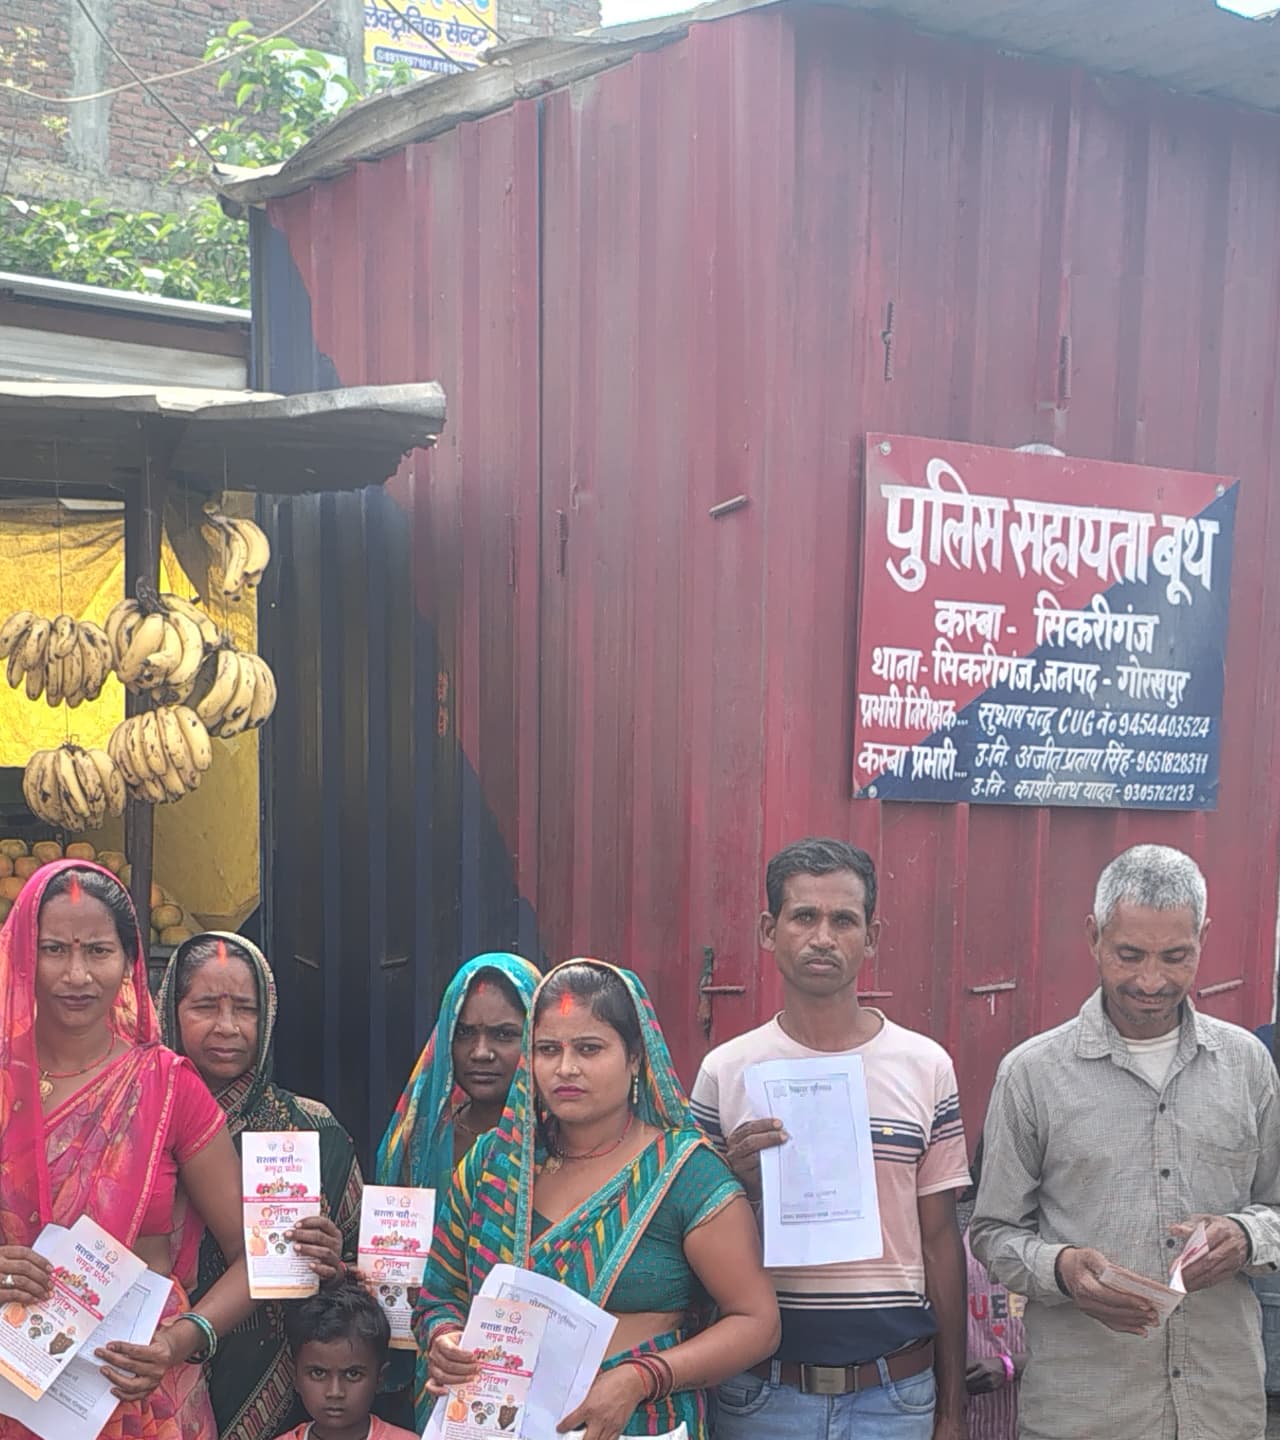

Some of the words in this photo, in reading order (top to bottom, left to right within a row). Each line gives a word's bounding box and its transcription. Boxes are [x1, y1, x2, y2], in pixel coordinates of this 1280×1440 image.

[880, 457, 1009, 593] पुलिस
[1009, 498, 1156, 585] सहायता
[1152, 513, 1220, 605] बूथ
[1033, 589, 1160, 653] सिकरीगंज
[1117, 654, 1191, 707] गोरखपुर
[858, 682, 904, 729] प्रभारी
[1058, 706, 1096, 737] CUG
[1117, 711, 1211, 738] 9454403524
[858, 741, 910, 776] कस्बा
[1015, 736, 1066, 774] अजीत
[969, 1293, 1028, 1320] UEE
